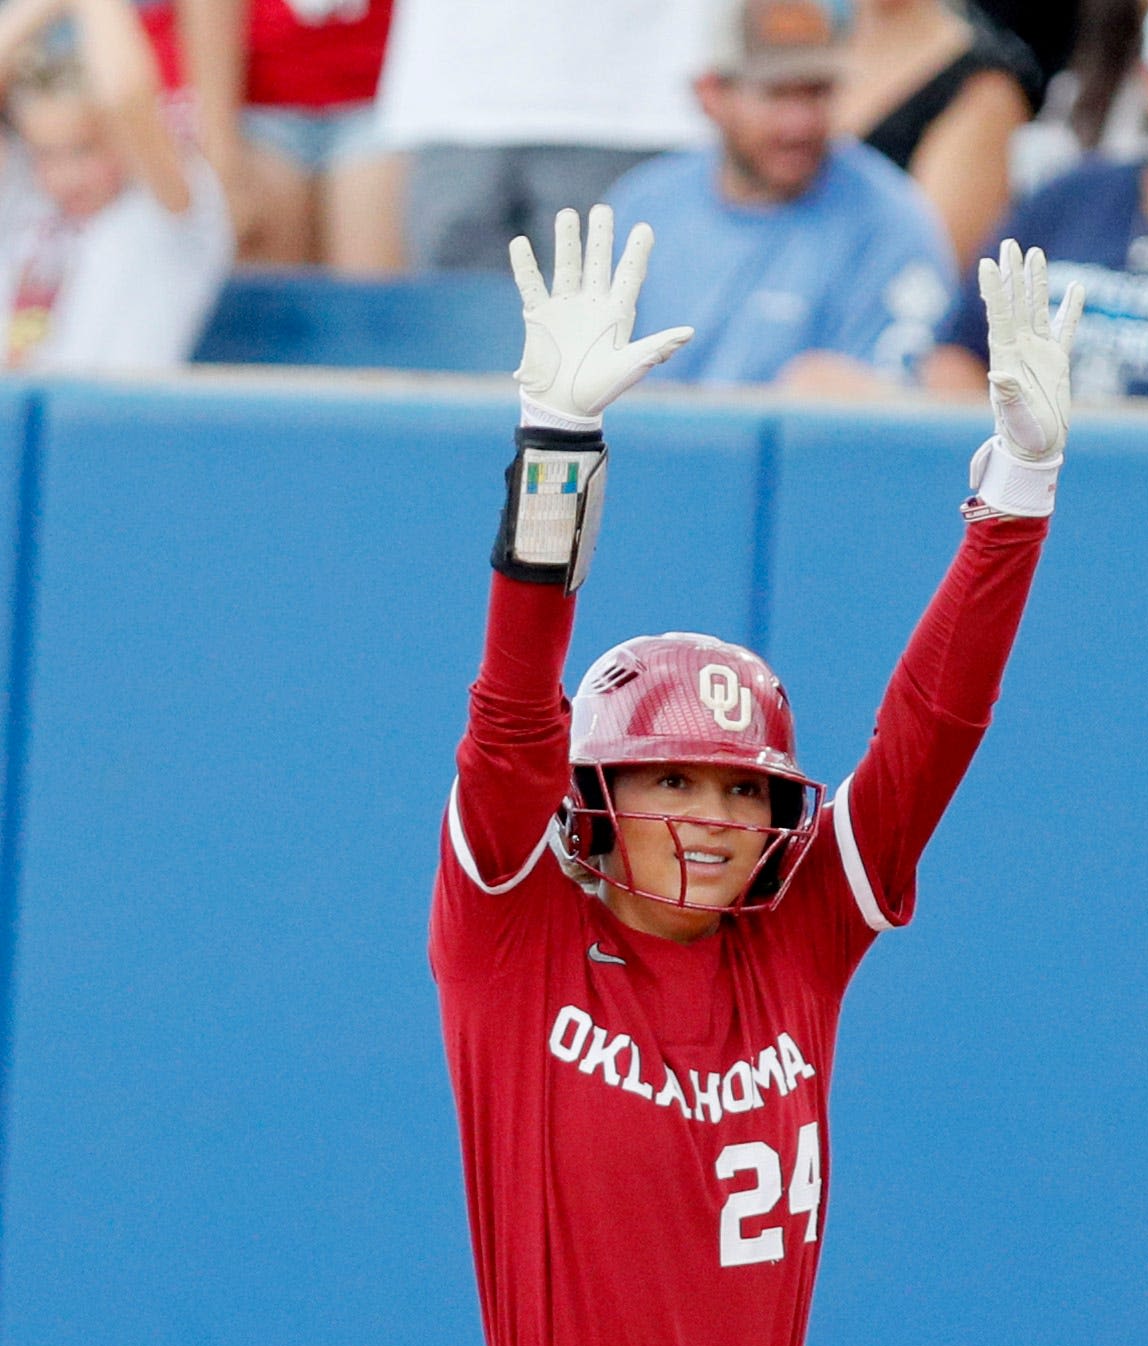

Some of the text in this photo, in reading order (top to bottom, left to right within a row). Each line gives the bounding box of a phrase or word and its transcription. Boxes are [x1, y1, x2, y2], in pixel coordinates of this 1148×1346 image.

[699, 663, 752, 731] OU
[549, 1004, 816, 1124] OKLAHOMA
[715, 1121, 822, 1267] 24
